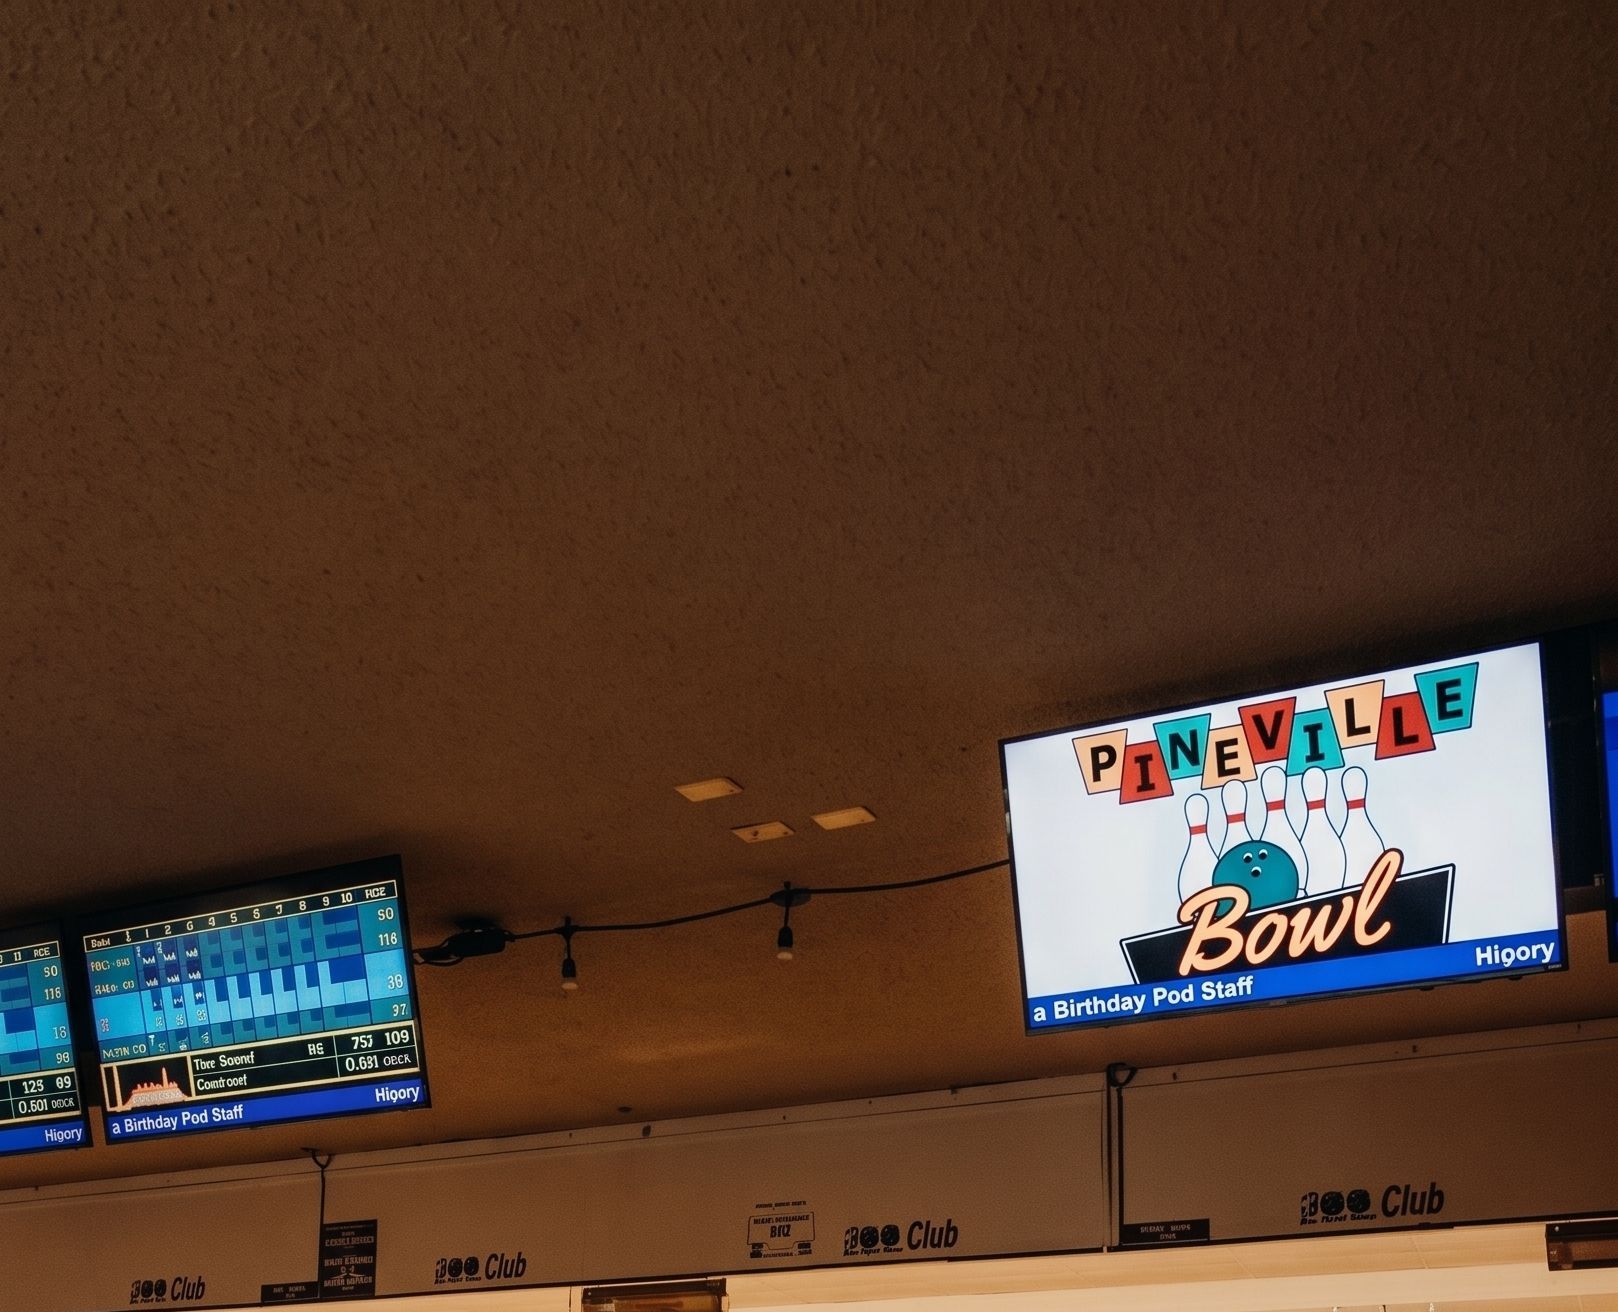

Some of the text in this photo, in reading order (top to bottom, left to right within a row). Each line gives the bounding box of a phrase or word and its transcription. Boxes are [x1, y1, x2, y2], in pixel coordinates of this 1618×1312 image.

[1089, 678, 1464, 793] PINEVILLE
[341, 892, 353, 903] 10
[1178, 849, 1404, 976] Bowl
[1033, 976, 1254, 1023] a Birthday Pod Staff
[112, 1104, 244, 1134] a Birthday Pod Staff
[45, 1126, 83, 1143] Higory
[1381, 1181, 1445, 1218] Club
[906, 1219, 959, 1250] Club
[484, 1251, 527, 1280] Club
[171, 1276, 206, 1301] Club
